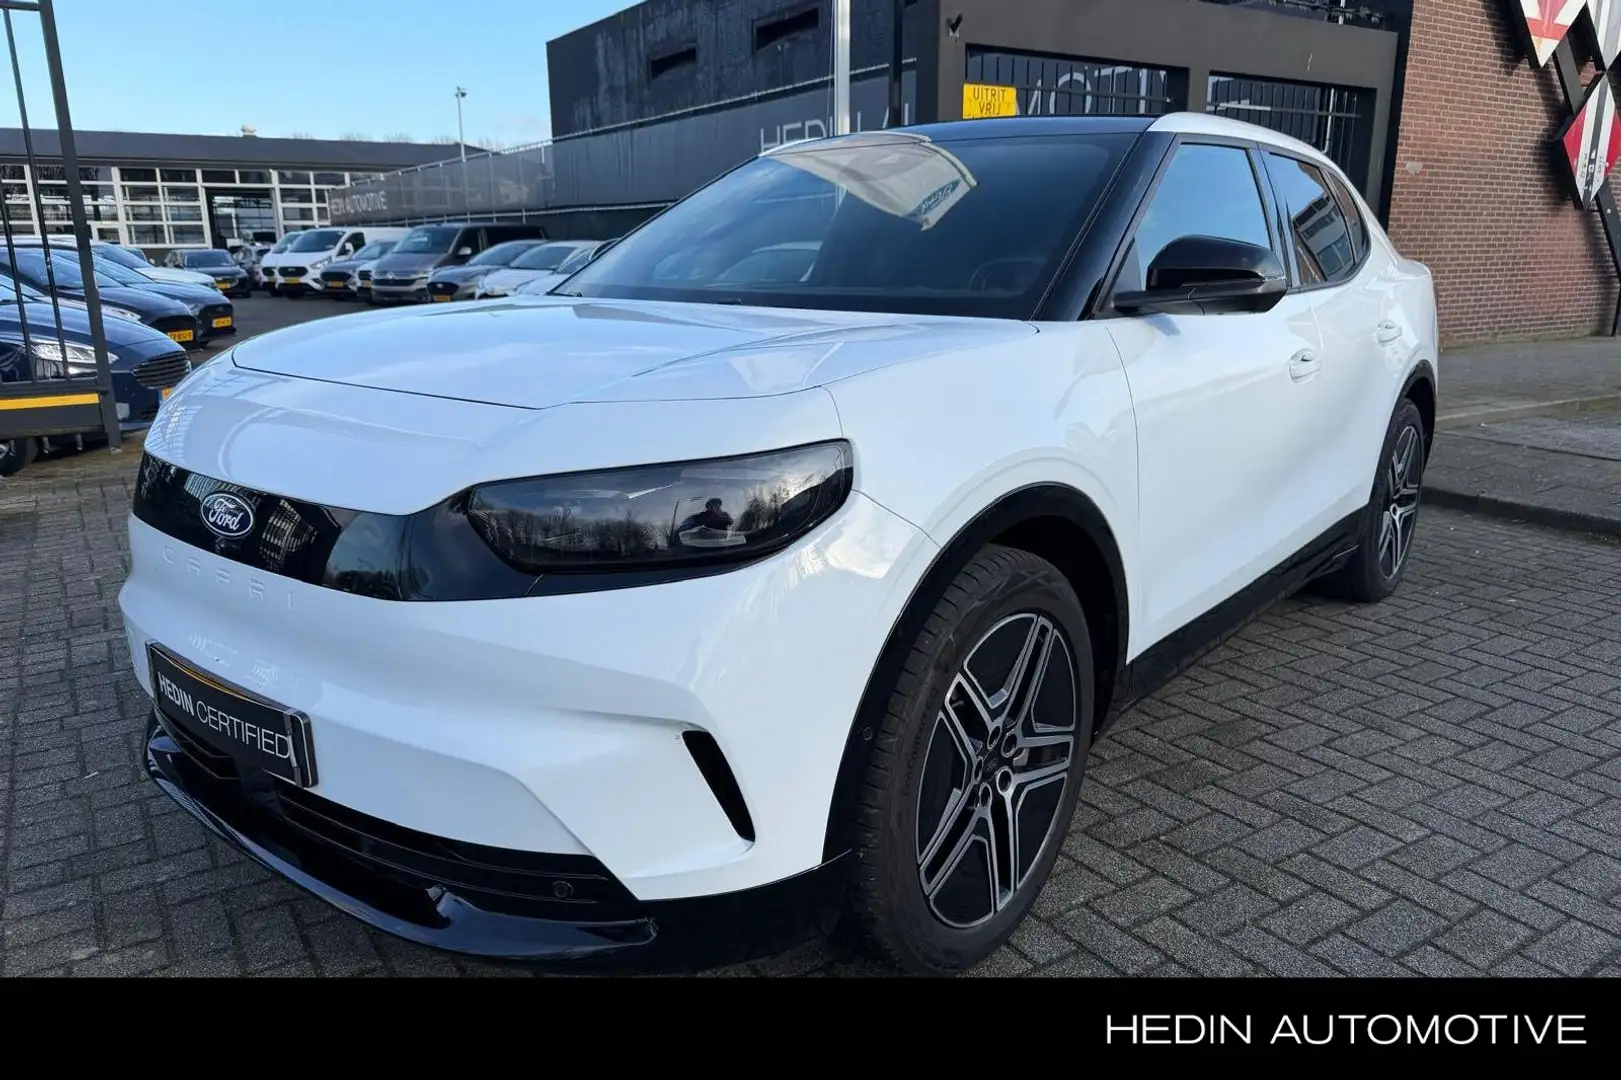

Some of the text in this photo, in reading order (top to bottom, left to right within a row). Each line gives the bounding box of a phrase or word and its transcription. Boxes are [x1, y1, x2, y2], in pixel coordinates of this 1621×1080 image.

[973, 88, 1007, 101] UITRIT
[978, 102, 1001, 115] VRIJ
[208, 497, 241, 531] Ford
[161, 544, 294, 610] CAPRI
[157, 671, 293, 759] HEDIN CERTIFIED
